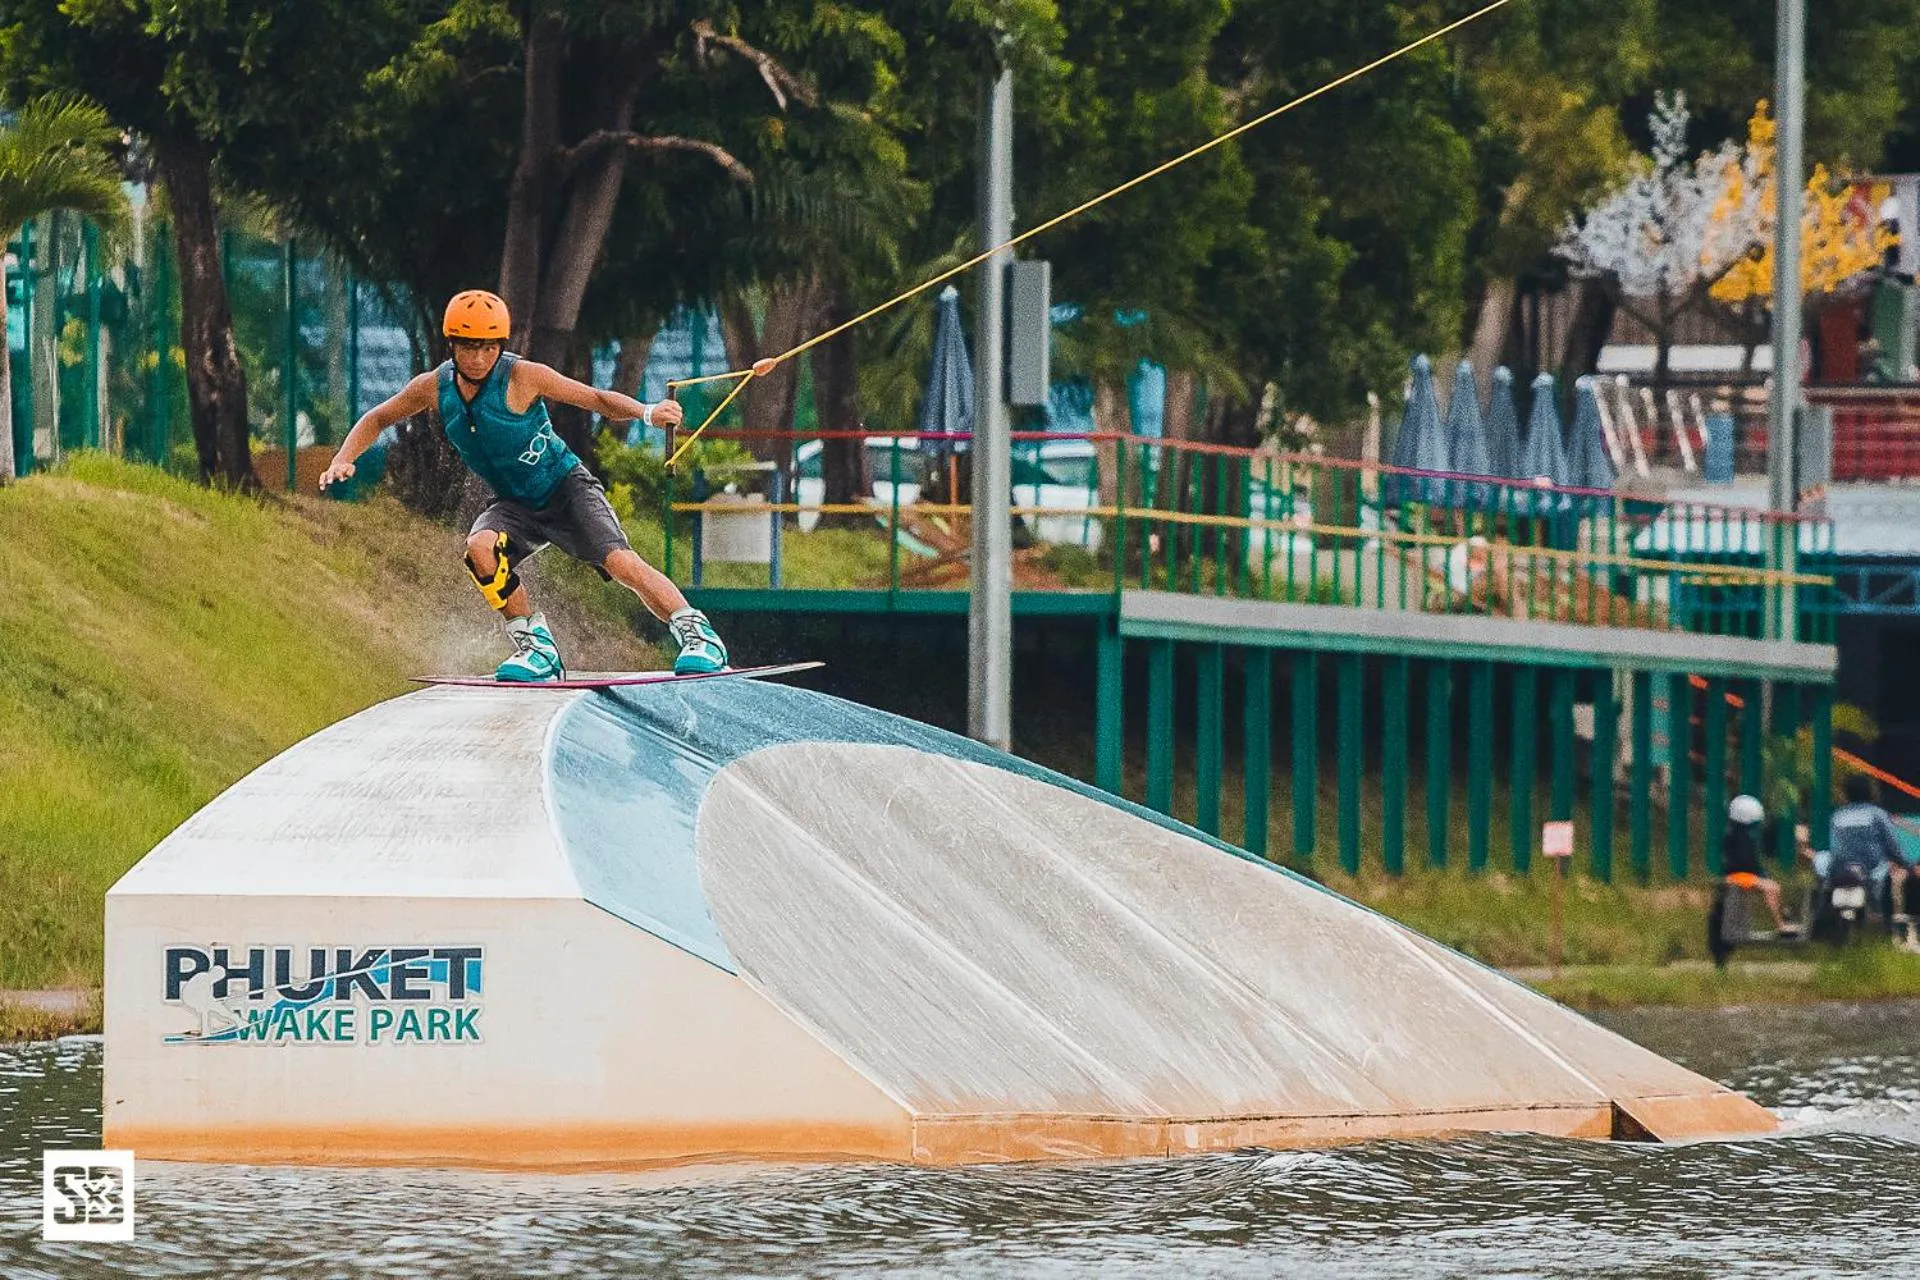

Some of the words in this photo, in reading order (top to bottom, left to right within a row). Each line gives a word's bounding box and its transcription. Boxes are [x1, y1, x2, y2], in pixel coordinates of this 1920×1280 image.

[165, 948, 483, 1000] PHUKET
[234, 1008, 354, 1041] WAKE
[370, 1008, 481, 1041] PARK
